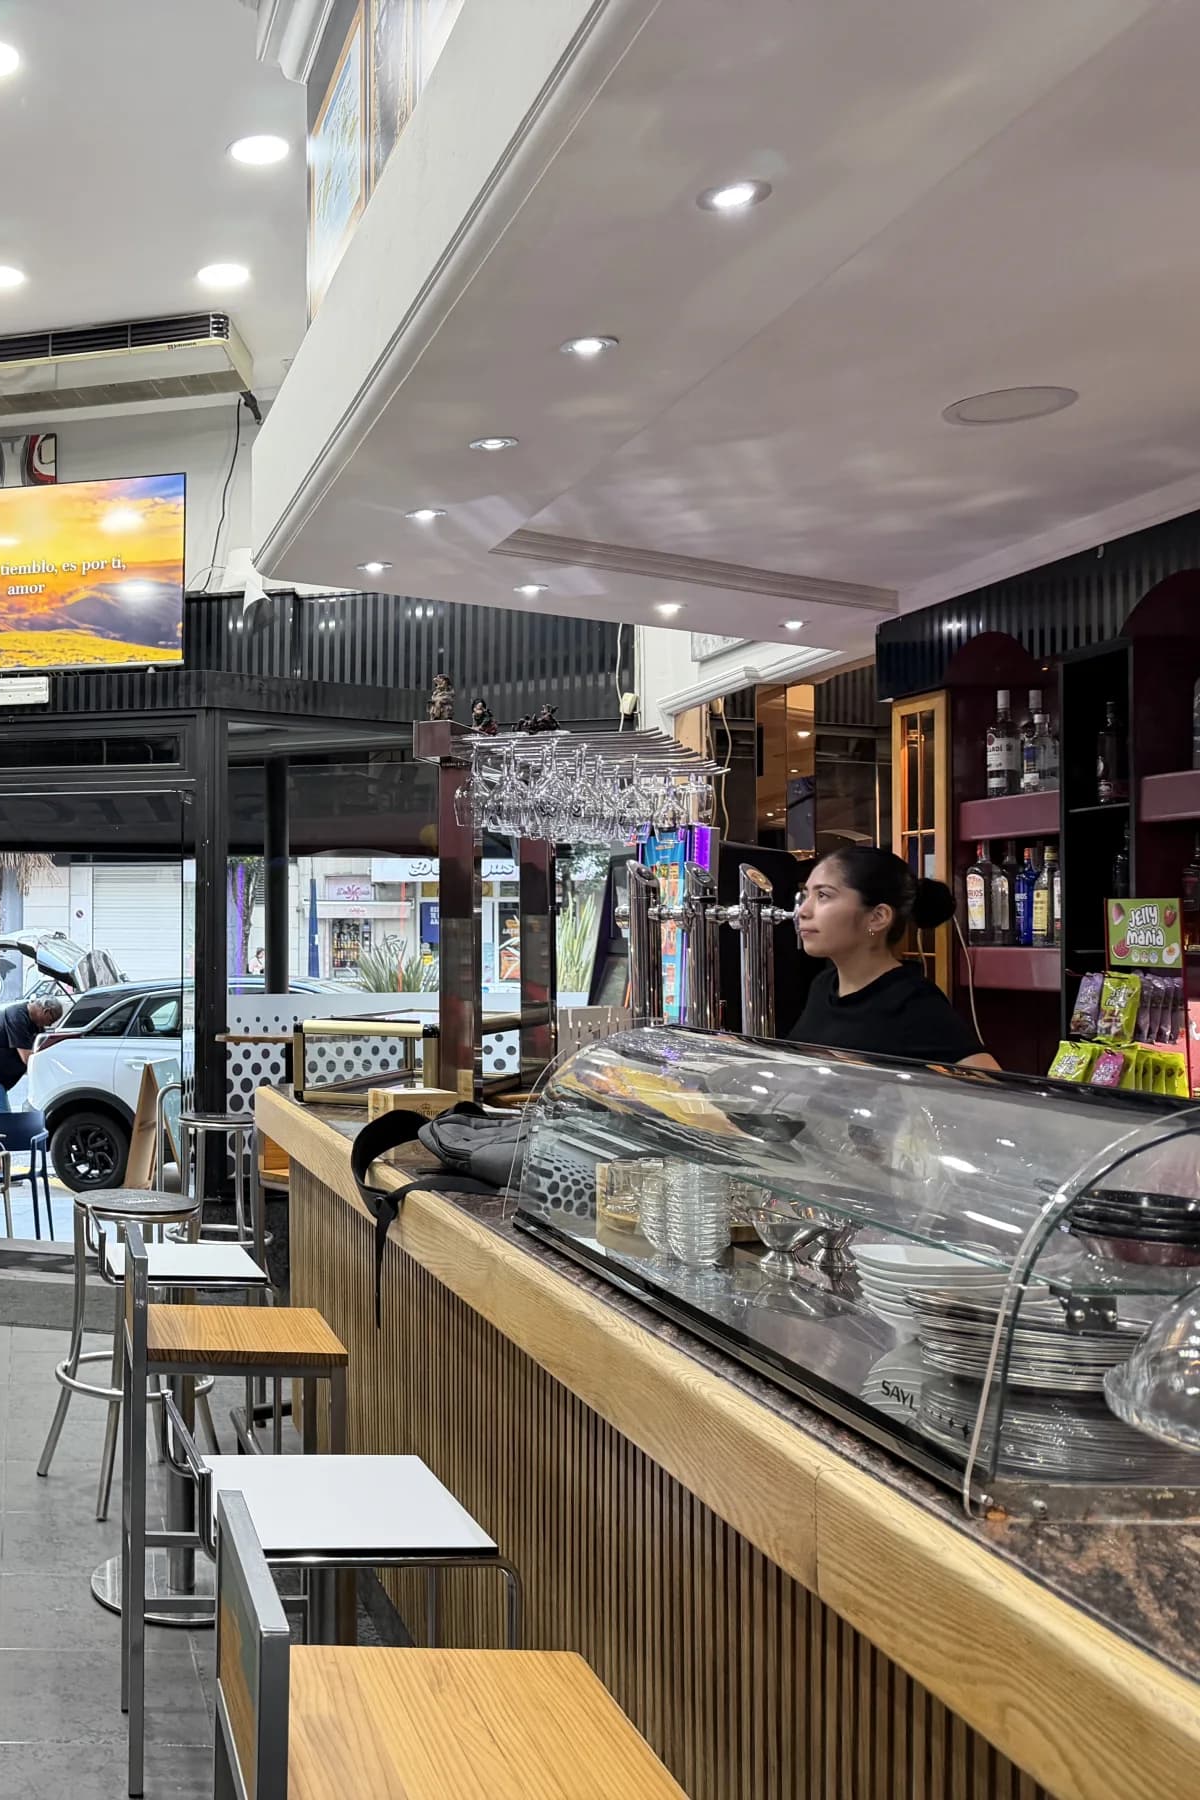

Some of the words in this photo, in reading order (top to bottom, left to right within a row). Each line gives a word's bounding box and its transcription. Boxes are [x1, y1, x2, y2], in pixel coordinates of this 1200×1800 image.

[0, 560, 59, 577] tiemblo,
[62, 562, 77, 573] es
[81, 558, 108, 576] por
[111, 554, 127, 572] ti,
[7, 583, 46, 597] amor
